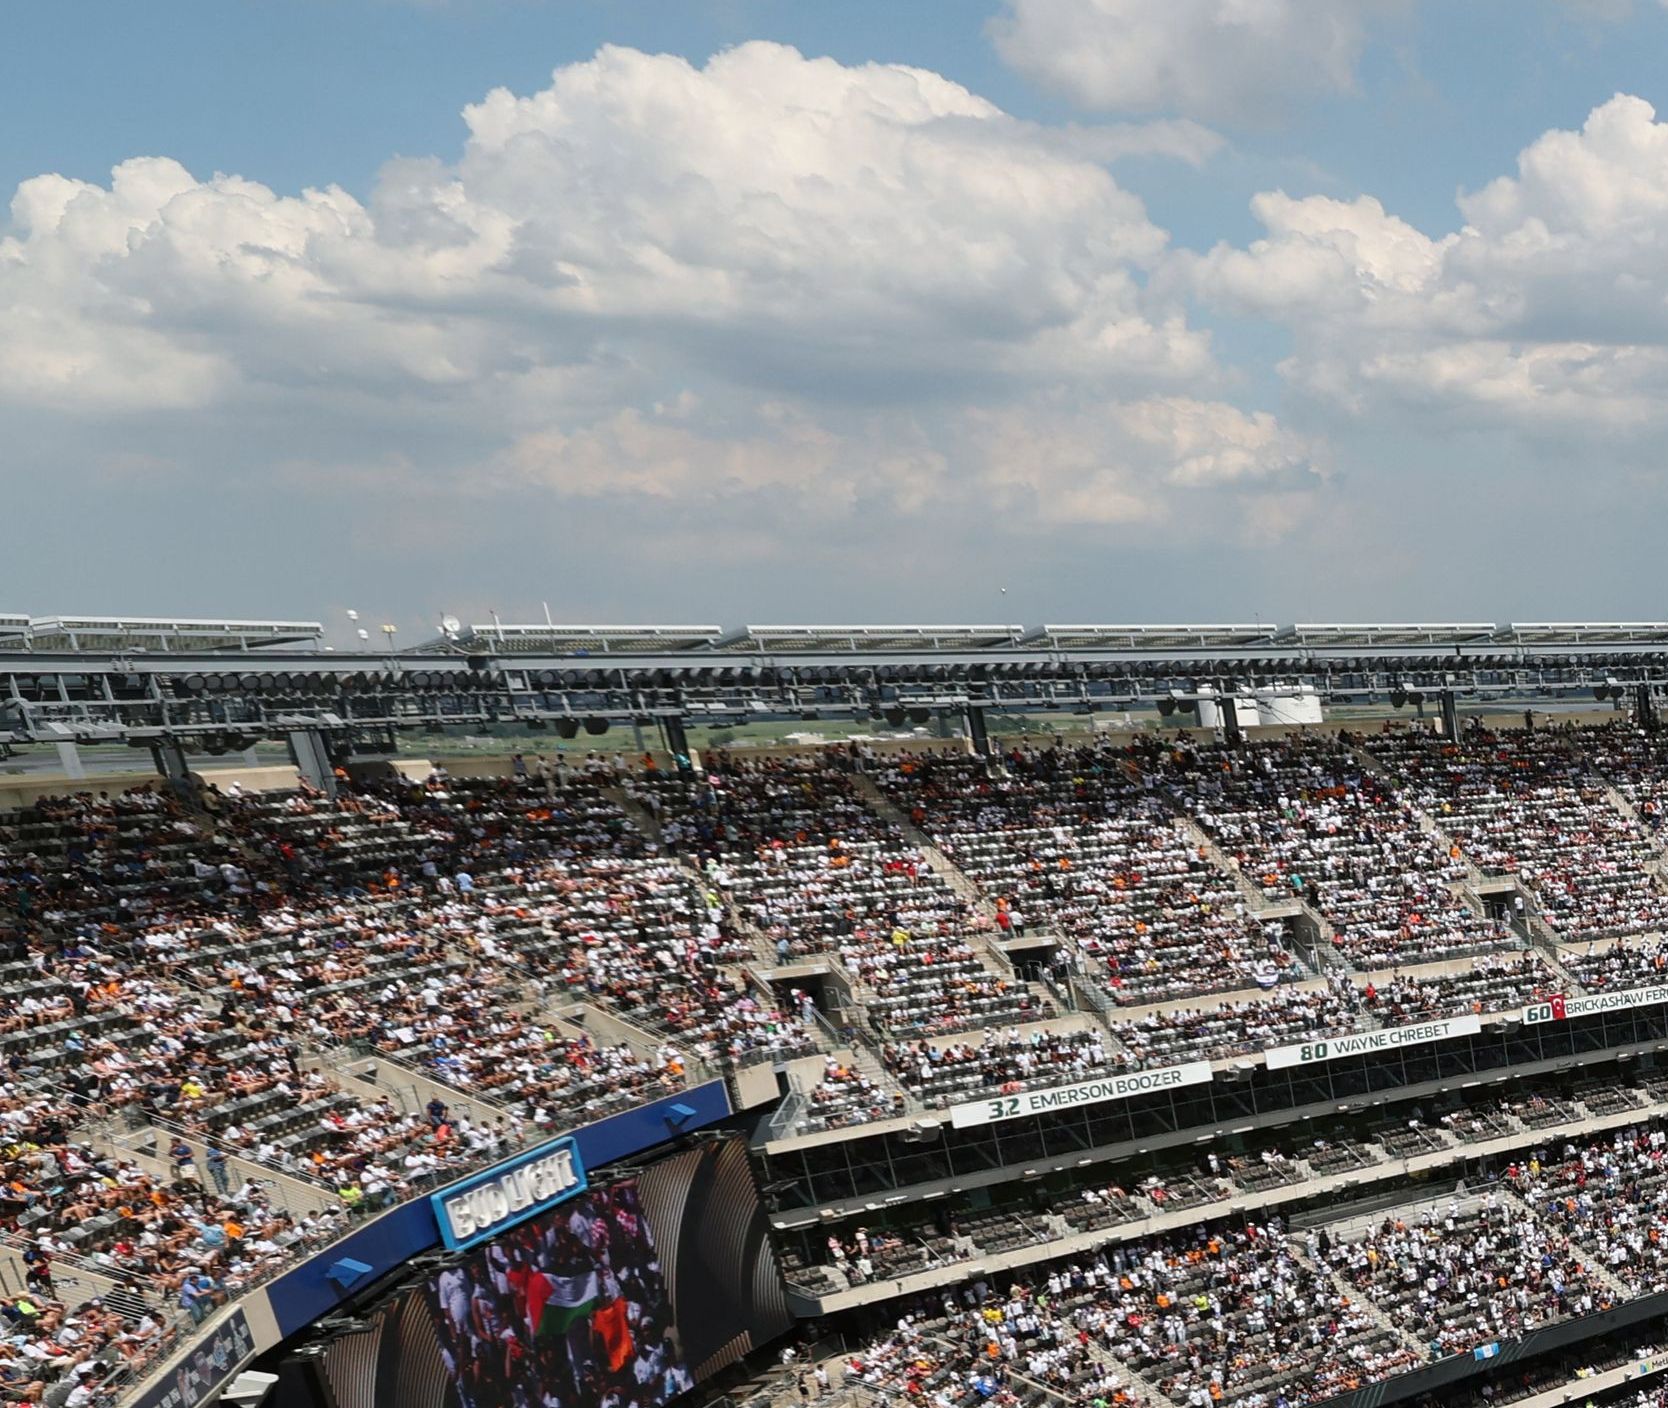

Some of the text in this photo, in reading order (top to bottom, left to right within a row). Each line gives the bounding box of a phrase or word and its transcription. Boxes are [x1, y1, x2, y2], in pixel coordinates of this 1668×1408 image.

[1526, 1005, 1551, 1023] 60
[1300, 1022, 1451, 1063] 80 WAYNE CHREBET
[988, 1069, 1183, 1121] 32 EMERSON BOOZER
[446, 1149, 580, 1240] BUD LIGHT
